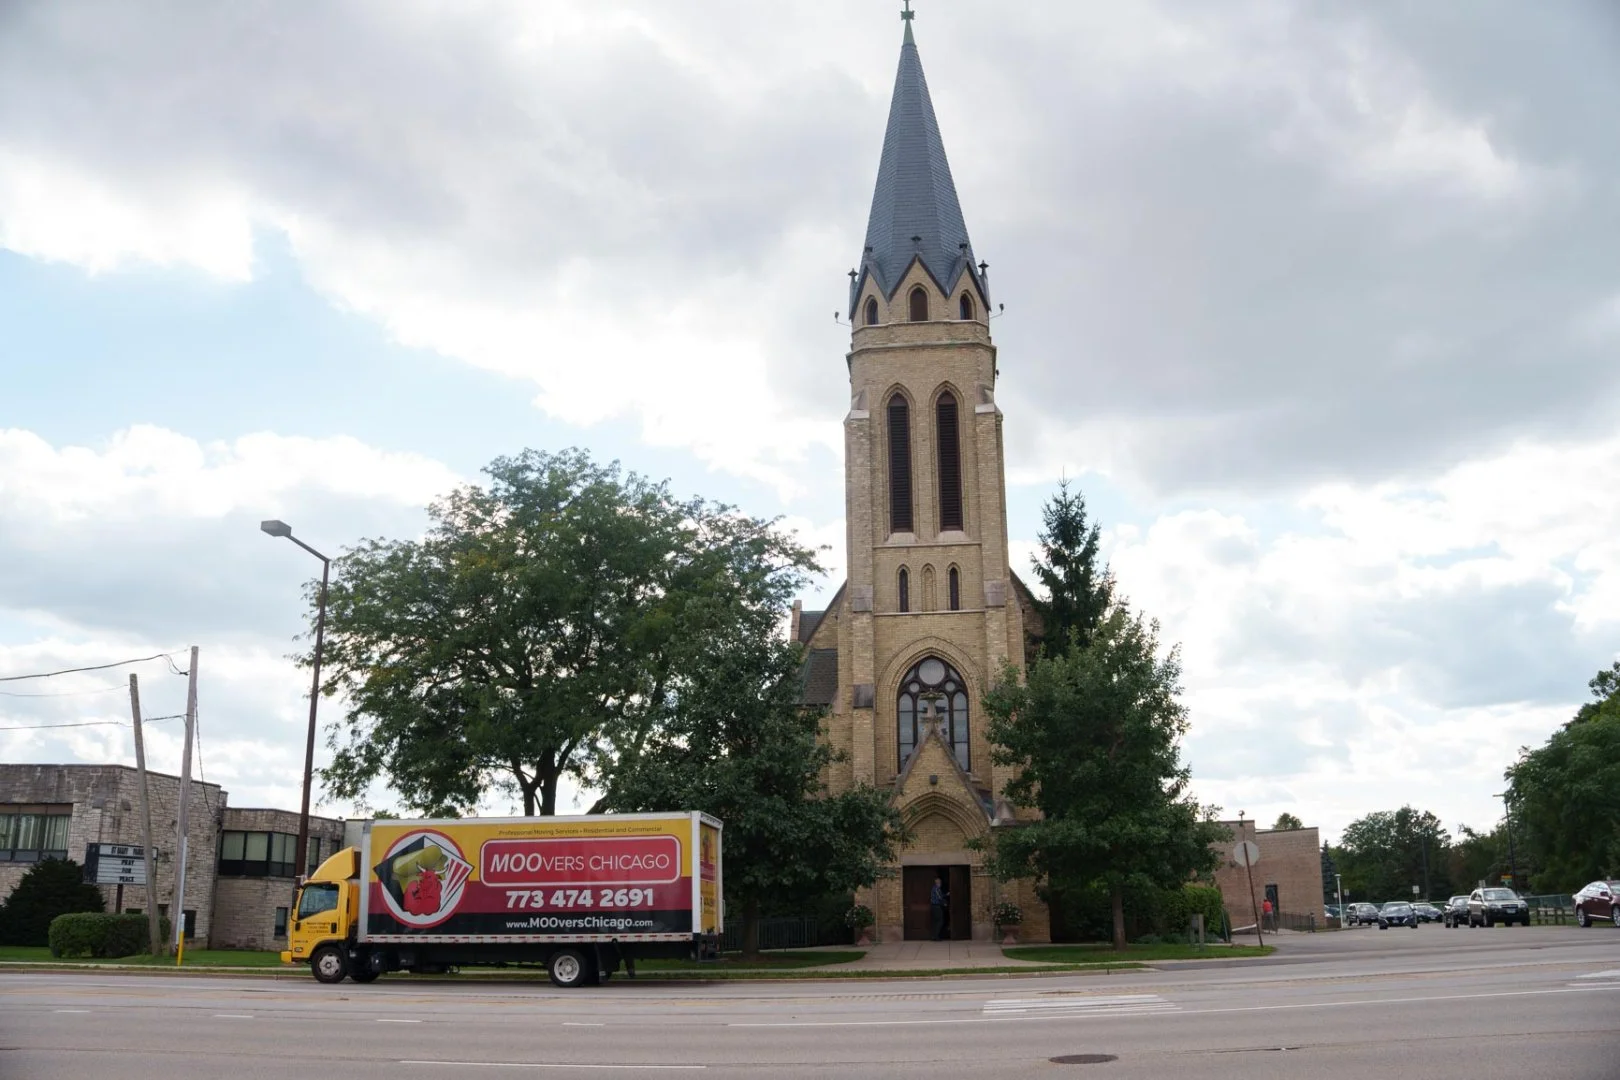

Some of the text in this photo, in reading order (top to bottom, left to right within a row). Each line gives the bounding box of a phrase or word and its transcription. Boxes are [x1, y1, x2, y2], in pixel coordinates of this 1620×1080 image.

[534, 828, 554, 836] Moving
[589, 853, 670, 871] CHICAGO
[505, 888, 654, 909] 773 474 2691
[505, 916, 654, 930] www.MOOversChicago.com
